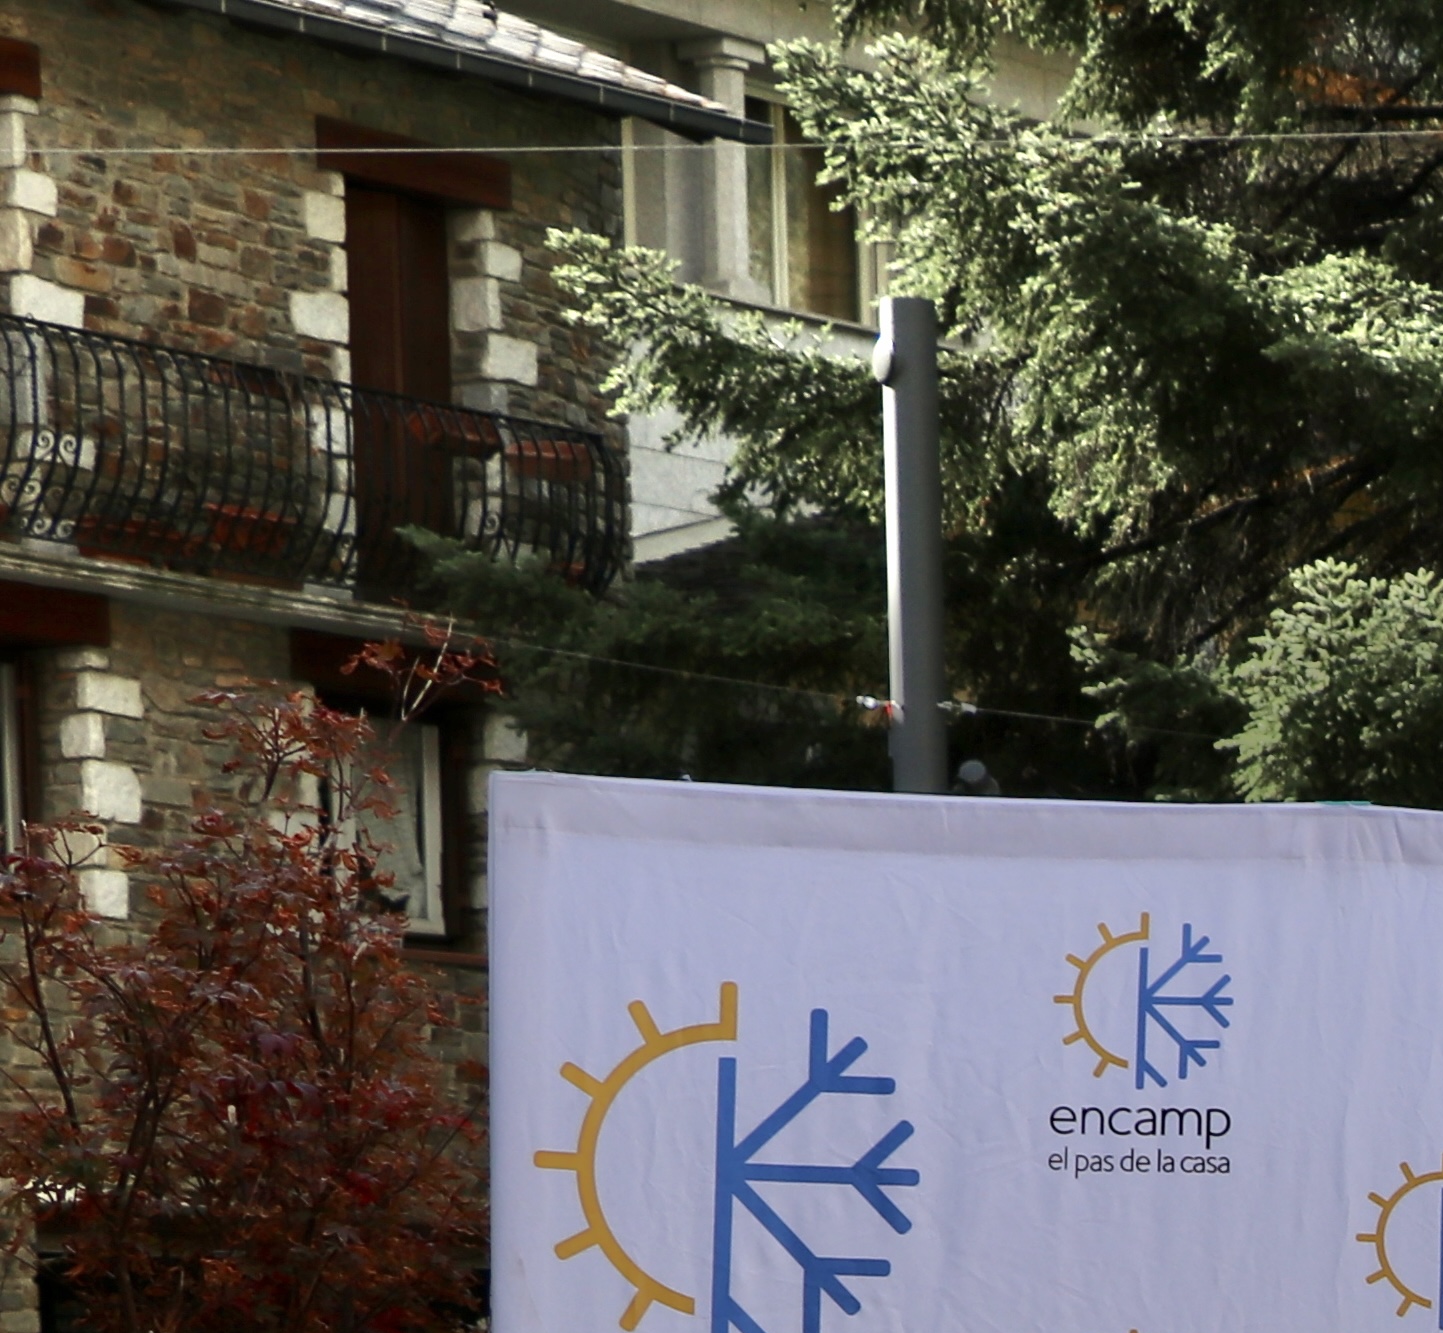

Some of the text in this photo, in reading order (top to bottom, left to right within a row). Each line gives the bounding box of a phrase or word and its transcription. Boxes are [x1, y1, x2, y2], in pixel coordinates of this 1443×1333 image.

[1049, 1106, 1232, 1151] encamp
[1048, 1146, 1231, 1179] el pas de la casa
